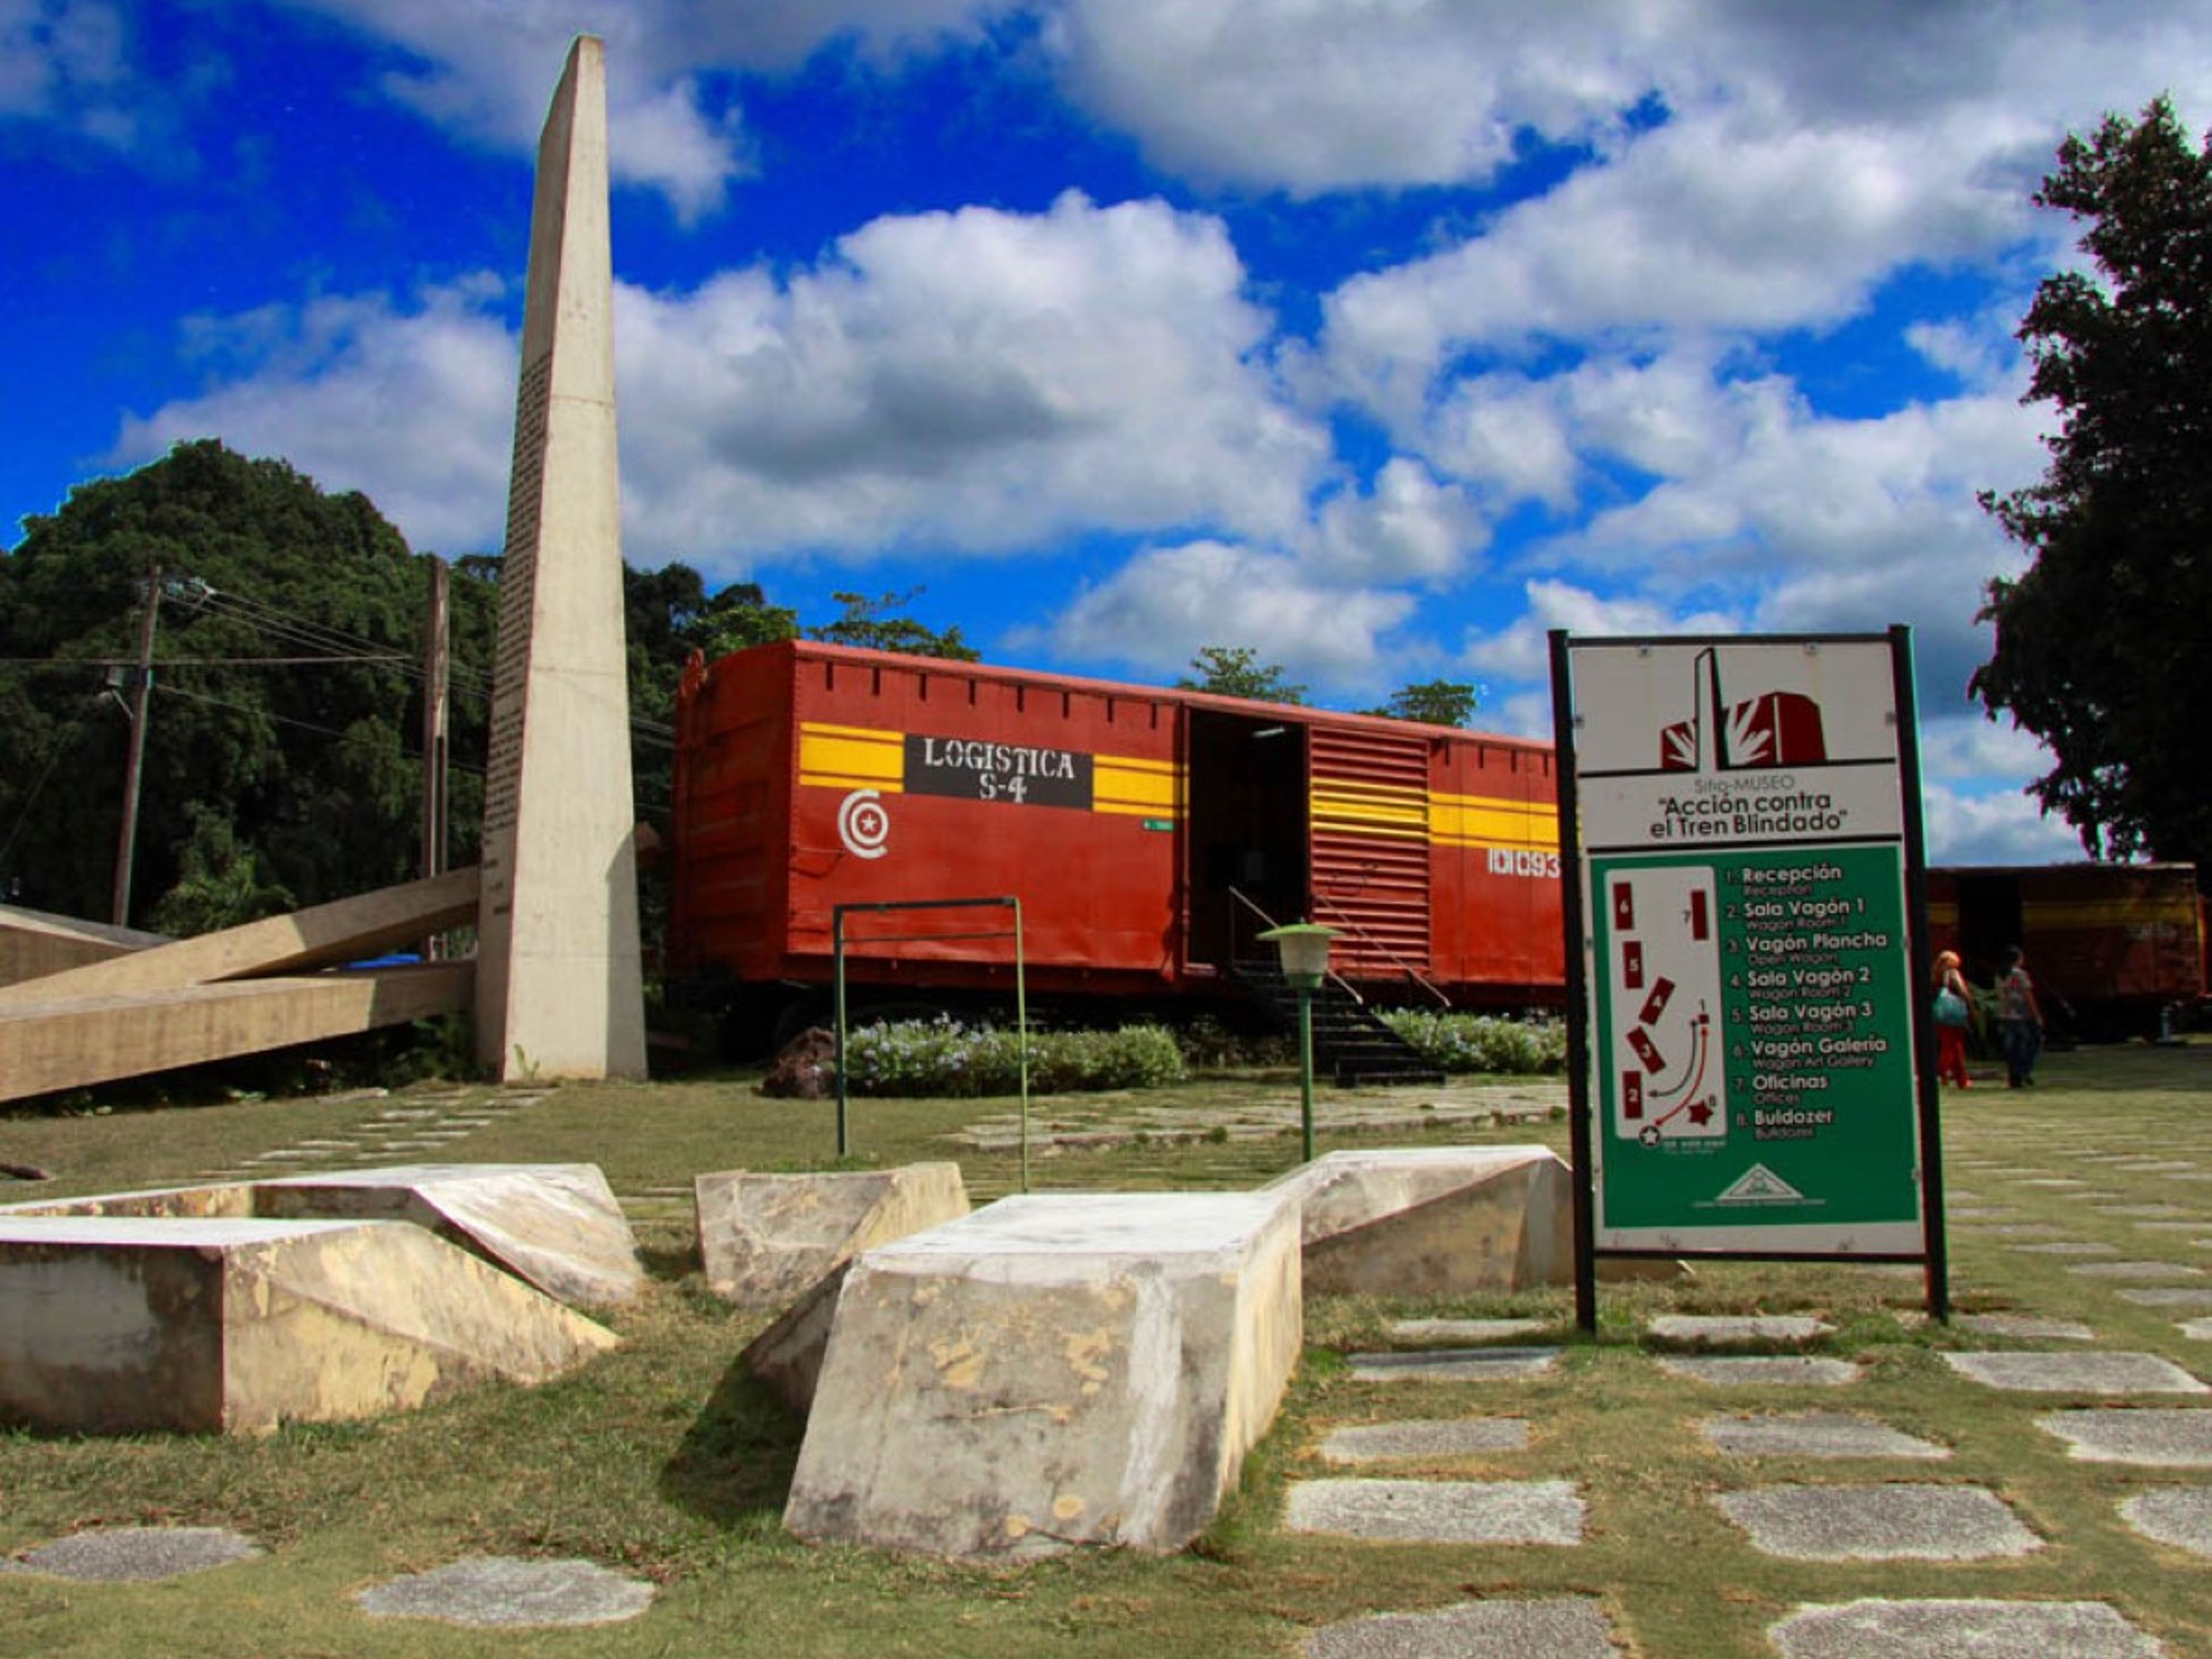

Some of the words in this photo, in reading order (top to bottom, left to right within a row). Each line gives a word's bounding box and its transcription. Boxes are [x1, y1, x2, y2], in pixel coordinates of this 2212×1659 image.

[923, 737, 1075, 779] LOGISTICA
[979, 772, 1028, 804] S-4
[1755, 790, 1831, 813] contra
[1650, 817, 1672, 838] el
[1677, 817, 1728, 838] Tren
[1743, 864, 1842, 885] Recepción
[1683, 910, 1691, 923] 7
[1744, 902, 1783, 916] Sala
[1789, 897, 1850, 918] Vagón
[1857, 897, 1865, 912] 1
[1746, 933, 1807, 953] Vagón
[1813, 932, 1887, 949] Plancha
[1629, 959, 1639, 972] 5
[1748, 971, 1786, 986] Sala
[1793, 967, 1855, 988] Vagón
[1859, 965, 1870, 982] 2
[1749, 1005, 1788, 1021] Sala
[1794, 1001, 1857, 1022] Vagón
[1861, 1002, 1872, 1016] 3
[1751, 1038, 1813, 1058] Vagón
[1753, 1074, 1828, 1090] Oficinas
[1627, 1088, 1638, 1103] 2
[1755, 1109, 1832, 1126] Buldozer
